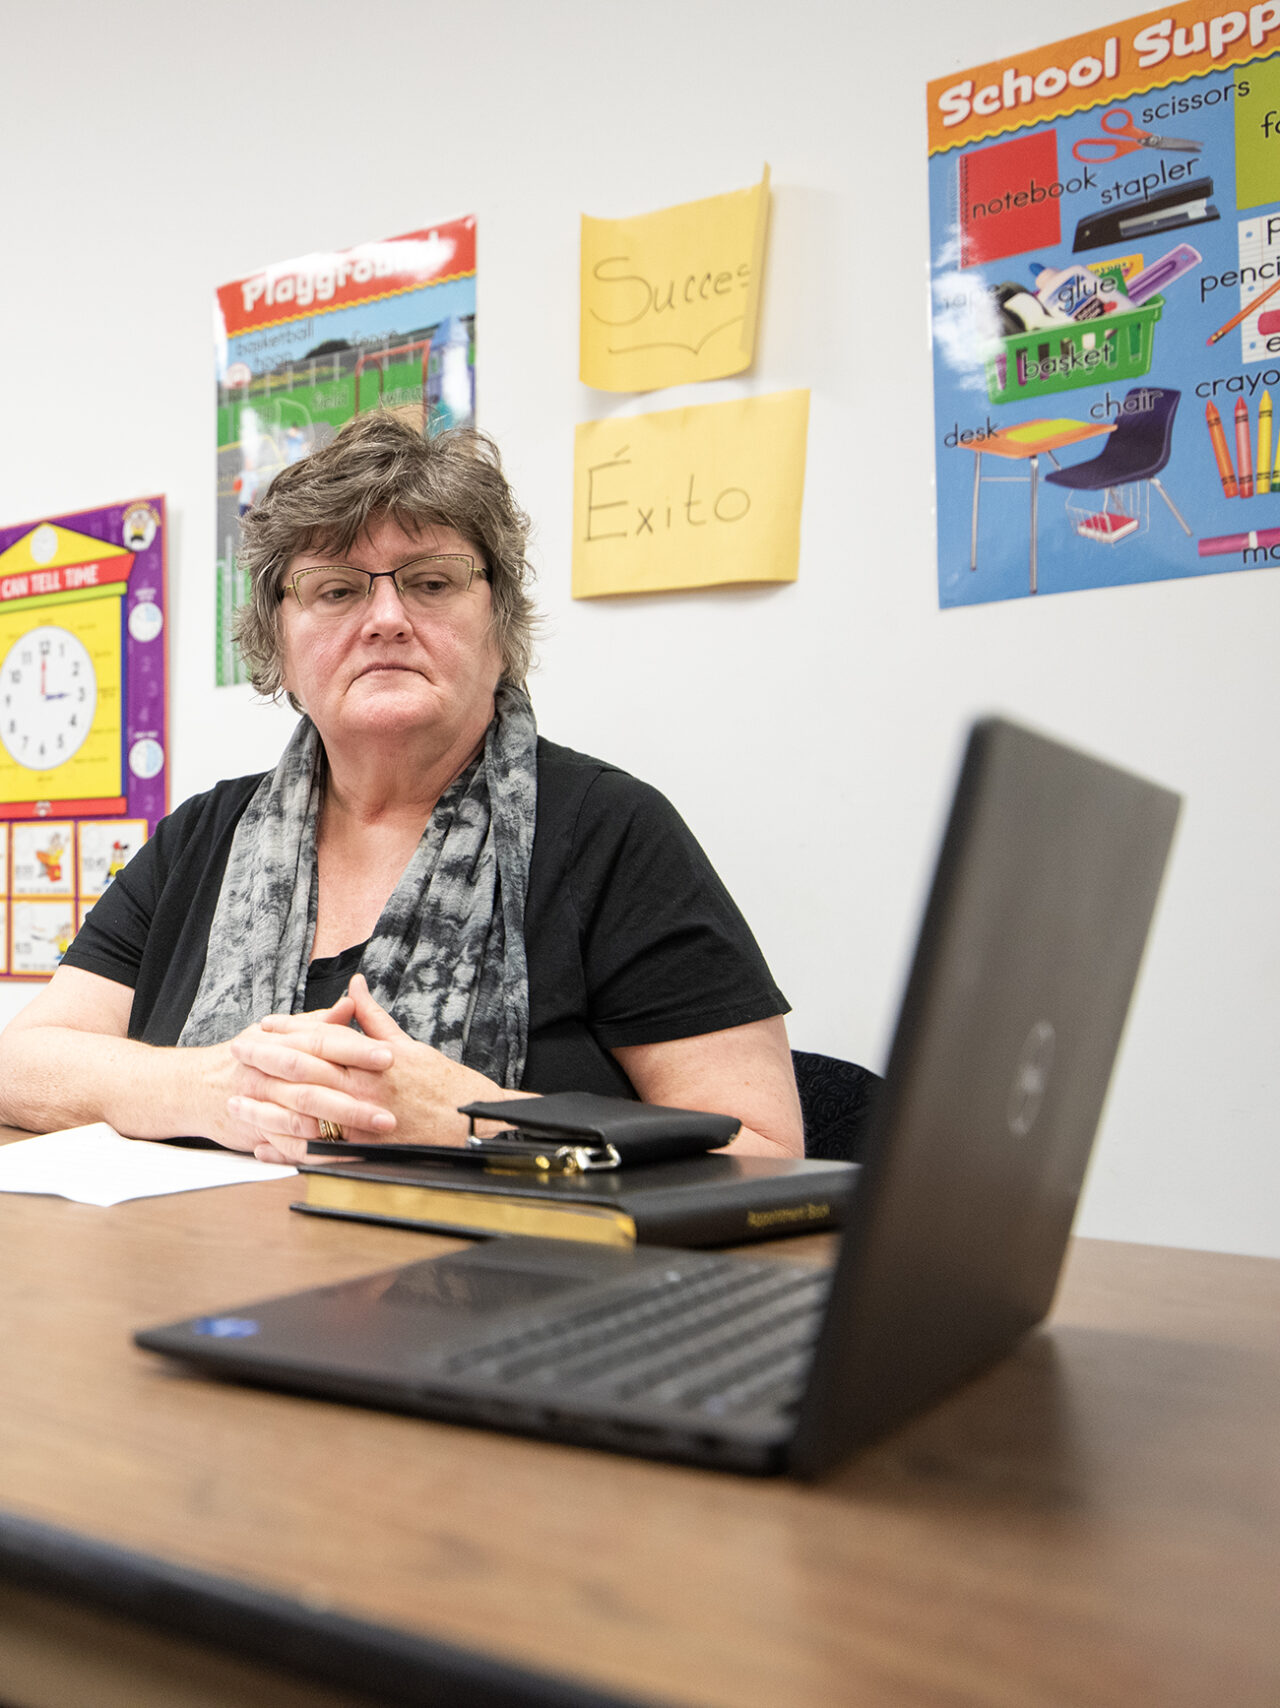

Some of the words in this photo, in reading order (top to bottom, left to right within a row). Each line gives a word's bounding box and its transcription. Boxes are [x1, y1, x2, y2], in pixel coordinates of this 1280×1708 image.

[938, 37, 1119, 127] School
[1142, 81, 1250, 124] scissors
[972, 166, 1098, 220] notebook
[1101, 158, 1200, 205] stapler
[1057, 273, 1116, 313] glue
[1023, 343, 1114, 379] basket
[1089, 389, 1163, 420] chair
[944, 417, 999, 448] desk
[583, 445, 751, 542] Éxito
[1, 577, 29, 598] CAN
[31, 571, 61, 592] TELL
[64, 564, 99, 588] TIME
